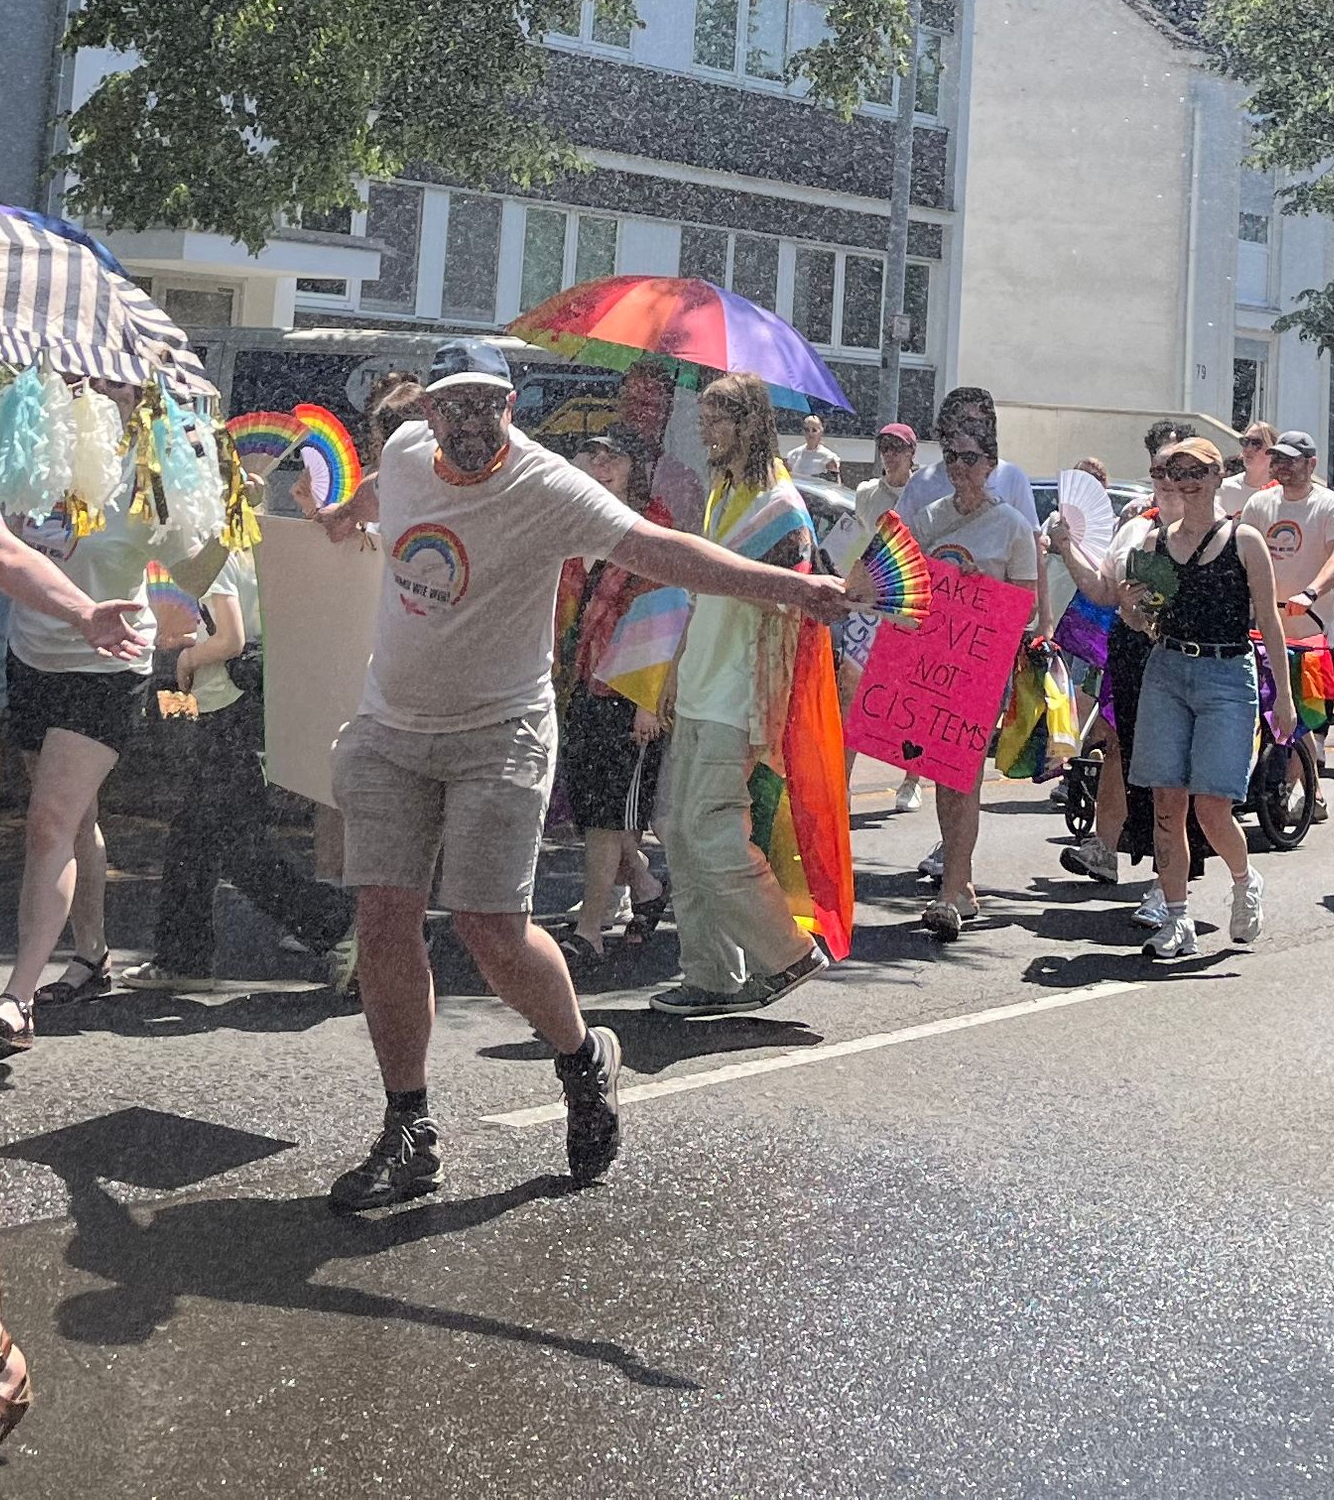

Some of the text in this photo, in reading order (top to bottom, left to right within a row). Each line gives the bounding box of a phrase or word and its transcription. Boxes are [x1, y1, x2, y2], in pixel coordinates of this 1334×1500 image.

[1195, 363, 1207, 380] 79
[930, 574, 992, 613] AKE
[917, 653, 972, 691] NOT
[861, 683, 988, 751] CIS-TEMS
